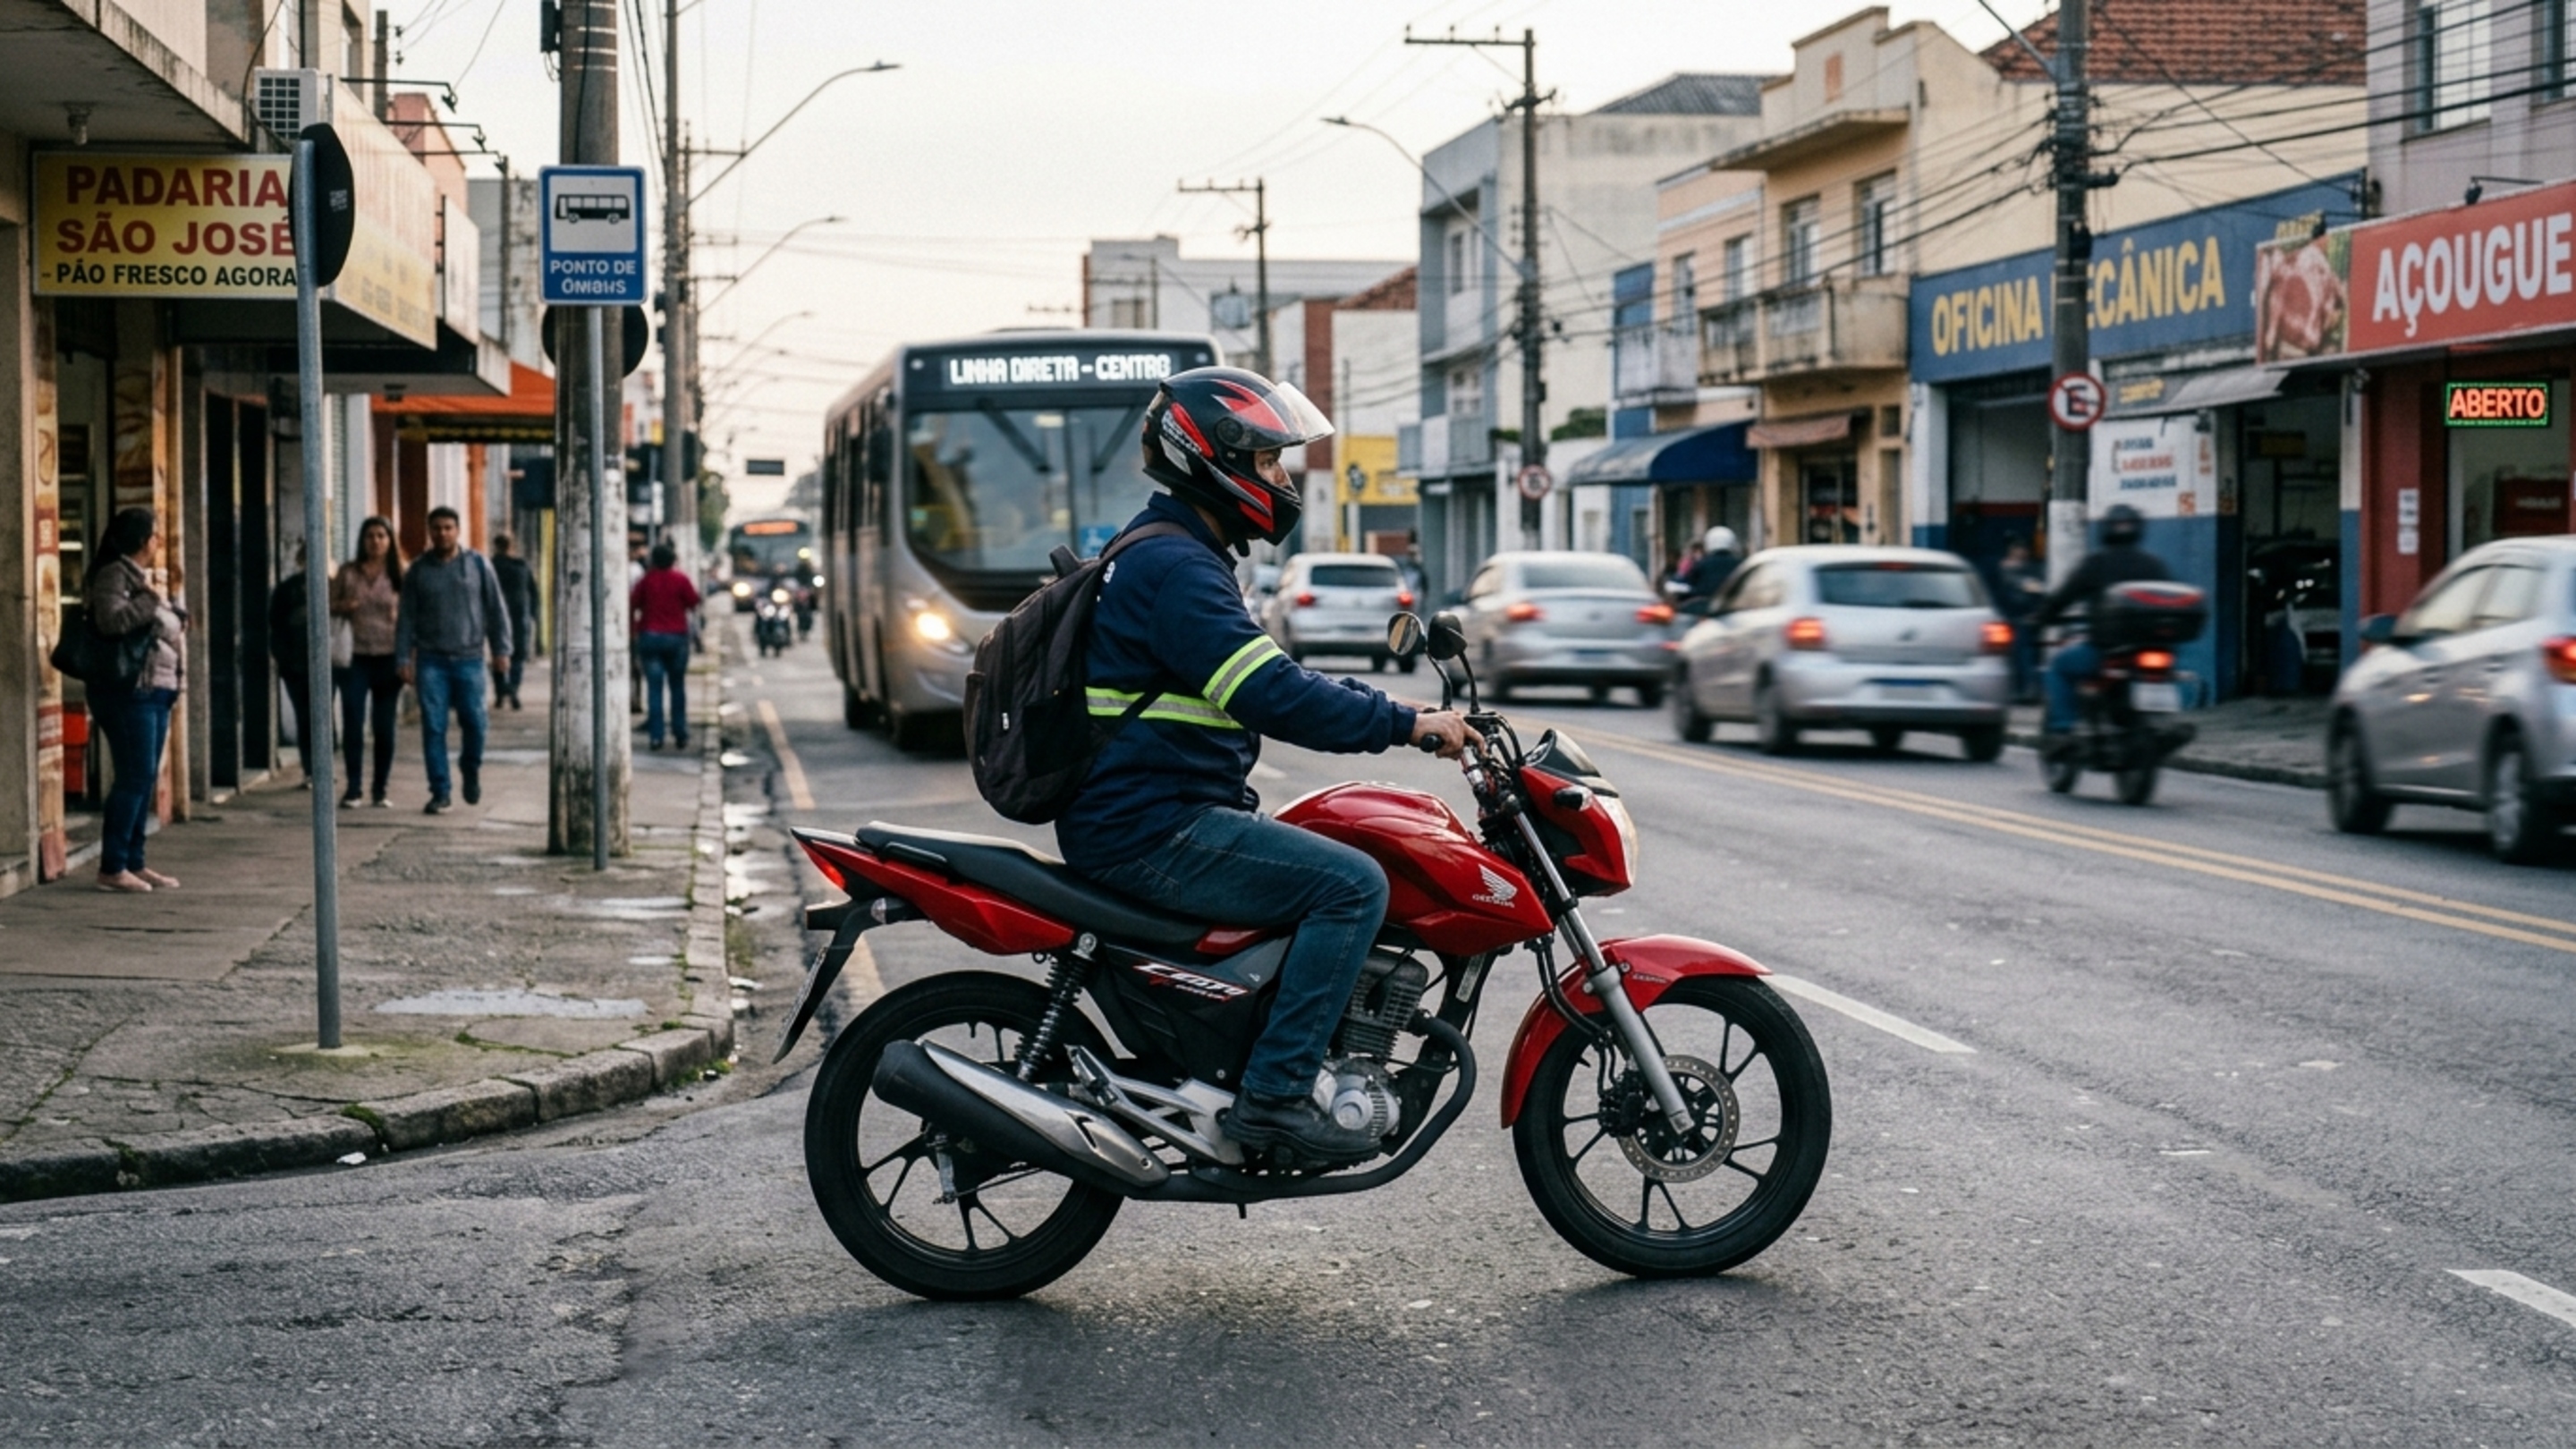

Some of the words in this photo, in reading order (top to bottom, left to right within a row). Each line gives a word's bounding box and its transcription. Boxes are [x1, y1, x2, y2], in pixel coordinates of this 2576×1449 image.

[67, 165, 287, 207] PADARIA
[56, 211, 156, 254] SÃO
[172, 216, 296, 256] JOSÉ
[114, 265, 207, 285] FRESCO
[215, 267, 297, 286] AGORA
[550, 259, 609, 275] PONTO
[614, 259, 636, 275] DE
[2372, 212, 2572, 338] AÇOUGUE
[1931, 276, 2044, 356] OFICINA
[2051, 236, 2225, 335] CÂNICA
[950, 359, 1007, 385] LINHA
[1010, 355, 1079, 383] DIRETA
[2449, 388, 2546, 418] ABERTO
